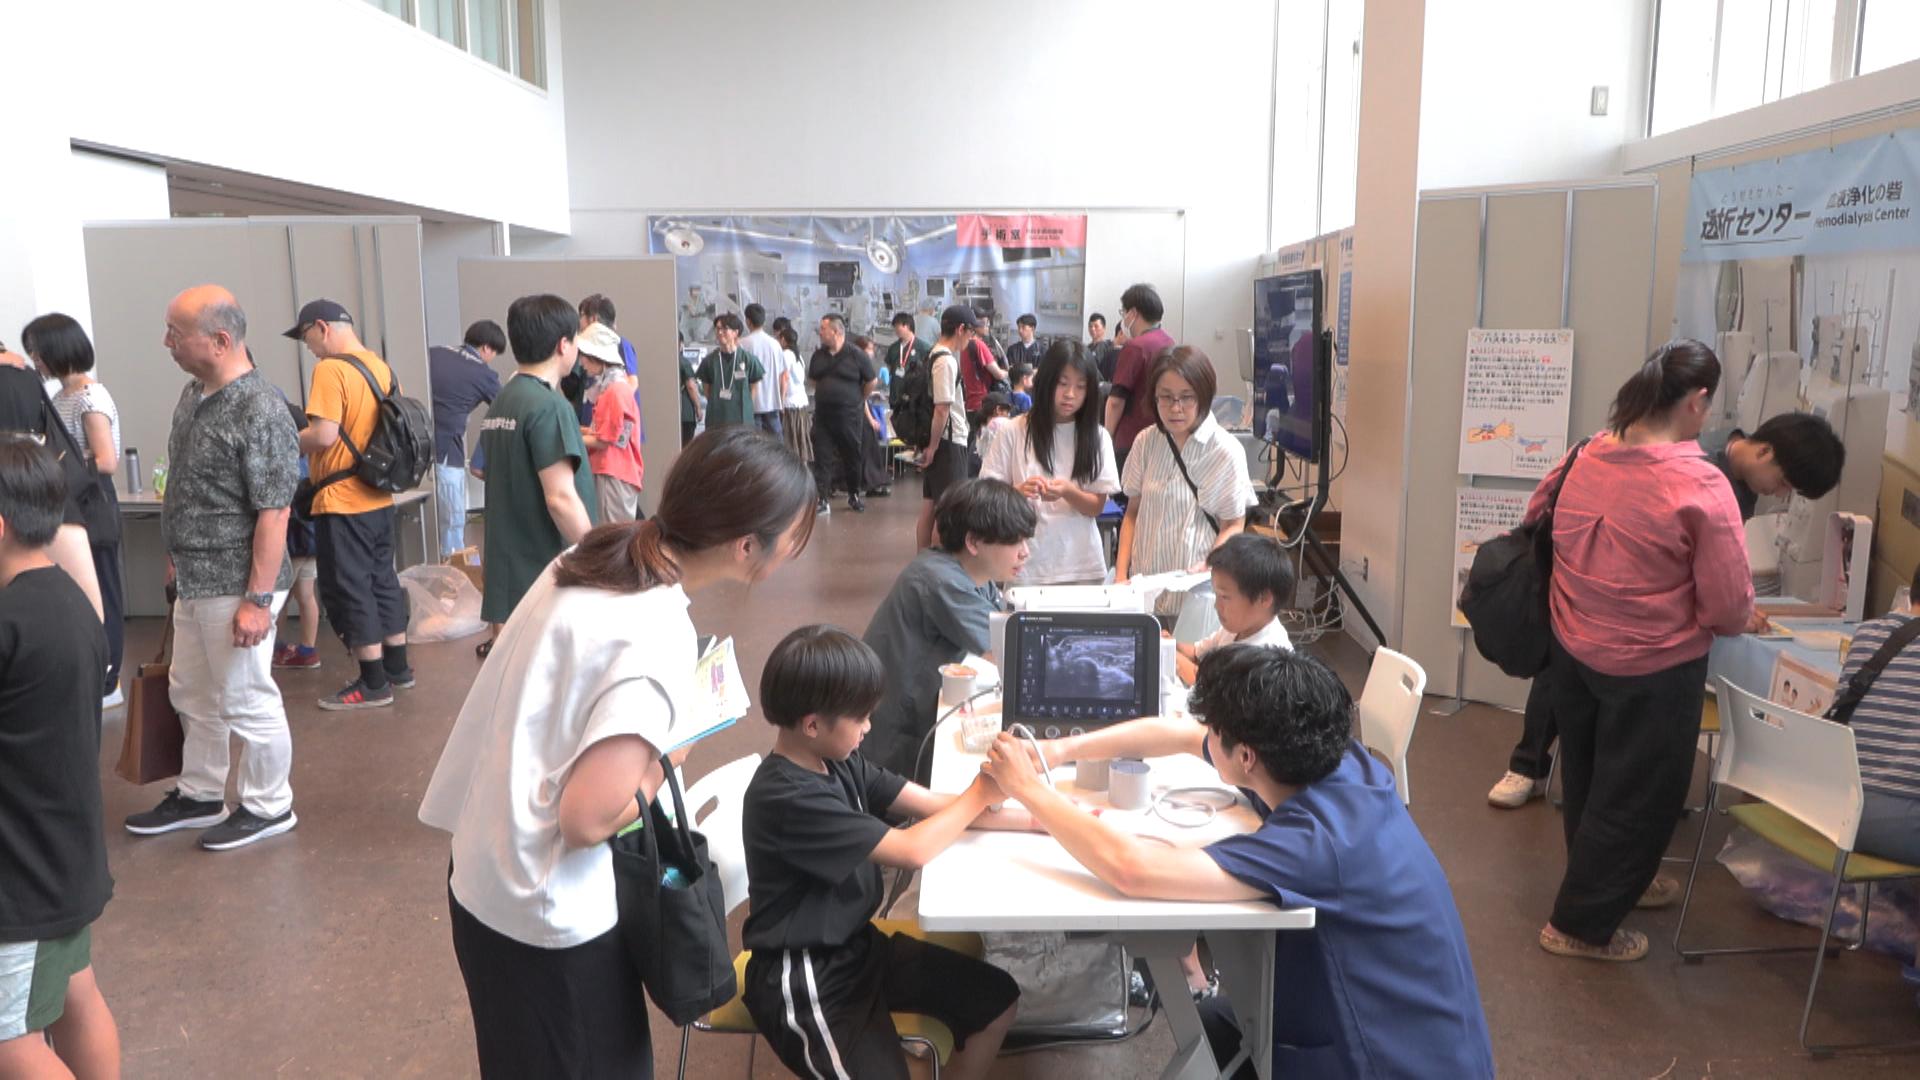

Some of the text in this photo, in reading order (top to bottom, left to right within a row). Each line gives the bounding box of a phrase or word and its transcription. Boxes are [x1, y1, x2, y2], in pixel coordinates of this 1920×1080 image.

[1701, 203, 1812, 240] 透析センター
[1874, 207, 1911, 221] Center
